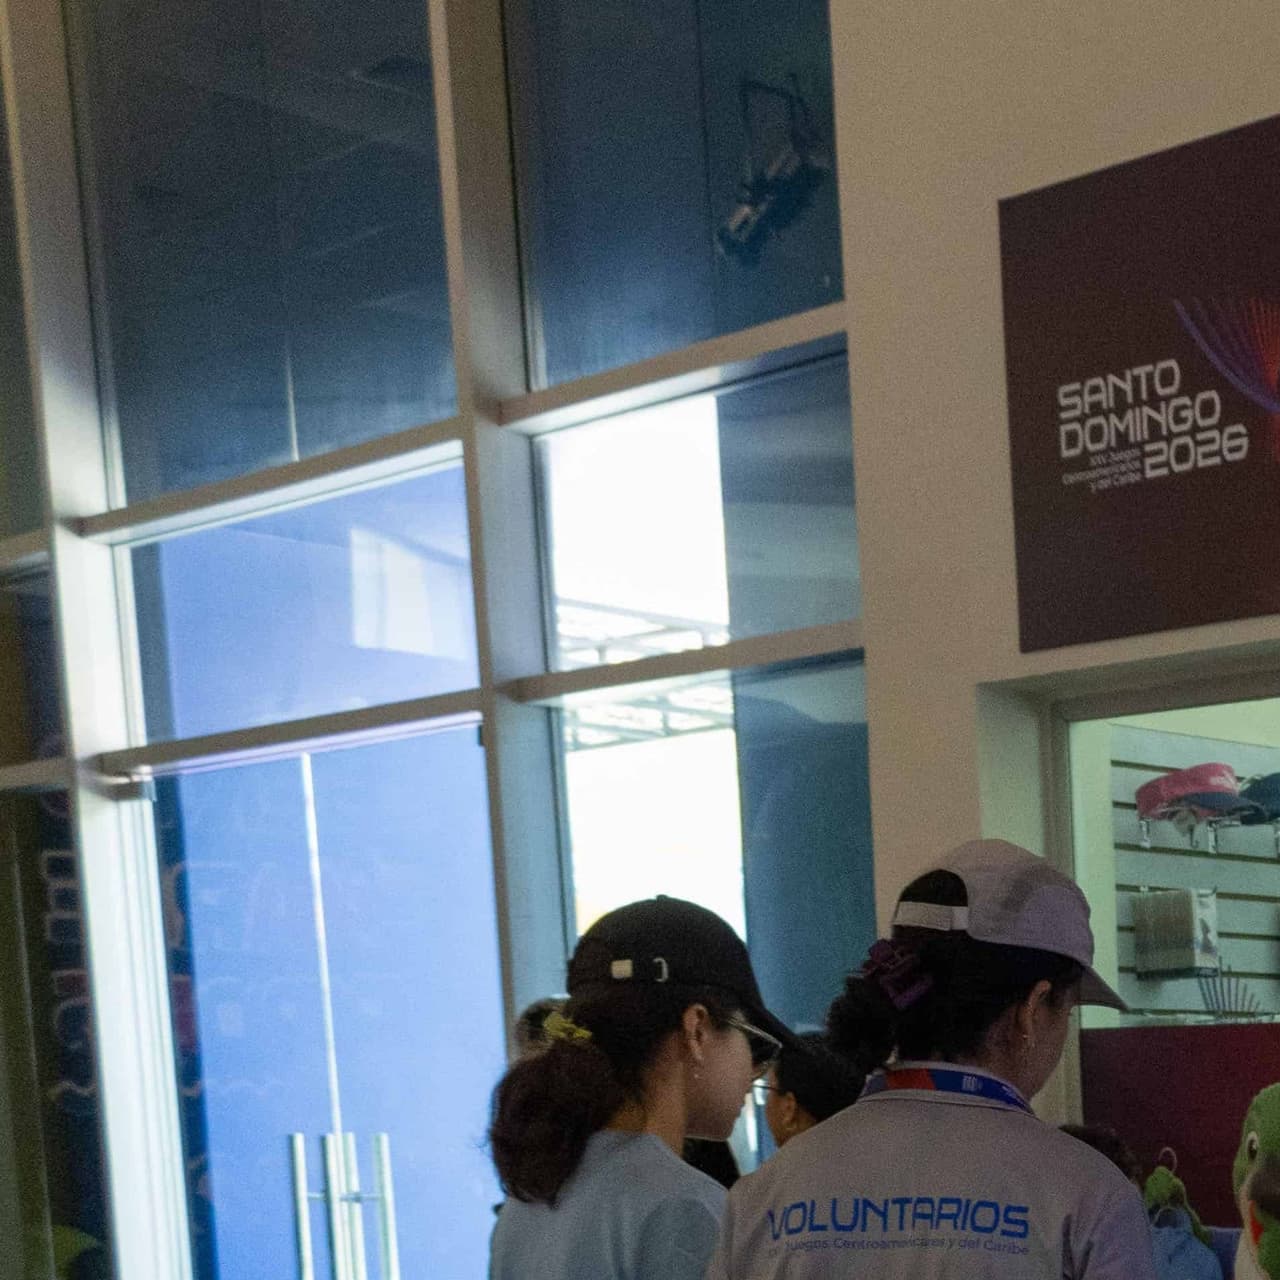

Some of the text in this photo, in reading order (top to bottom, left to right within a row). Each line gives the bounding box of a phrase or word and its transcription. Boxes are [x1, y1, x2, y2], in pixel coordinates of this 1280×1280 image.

[1057, 359, 1180, 420] SANTO
[1060, 390, 1221, 459] DOMINGO
[1144, 423, 1248, 479] 2026
[767, 1197, 1030, 1241] VOLUNTARIOS
